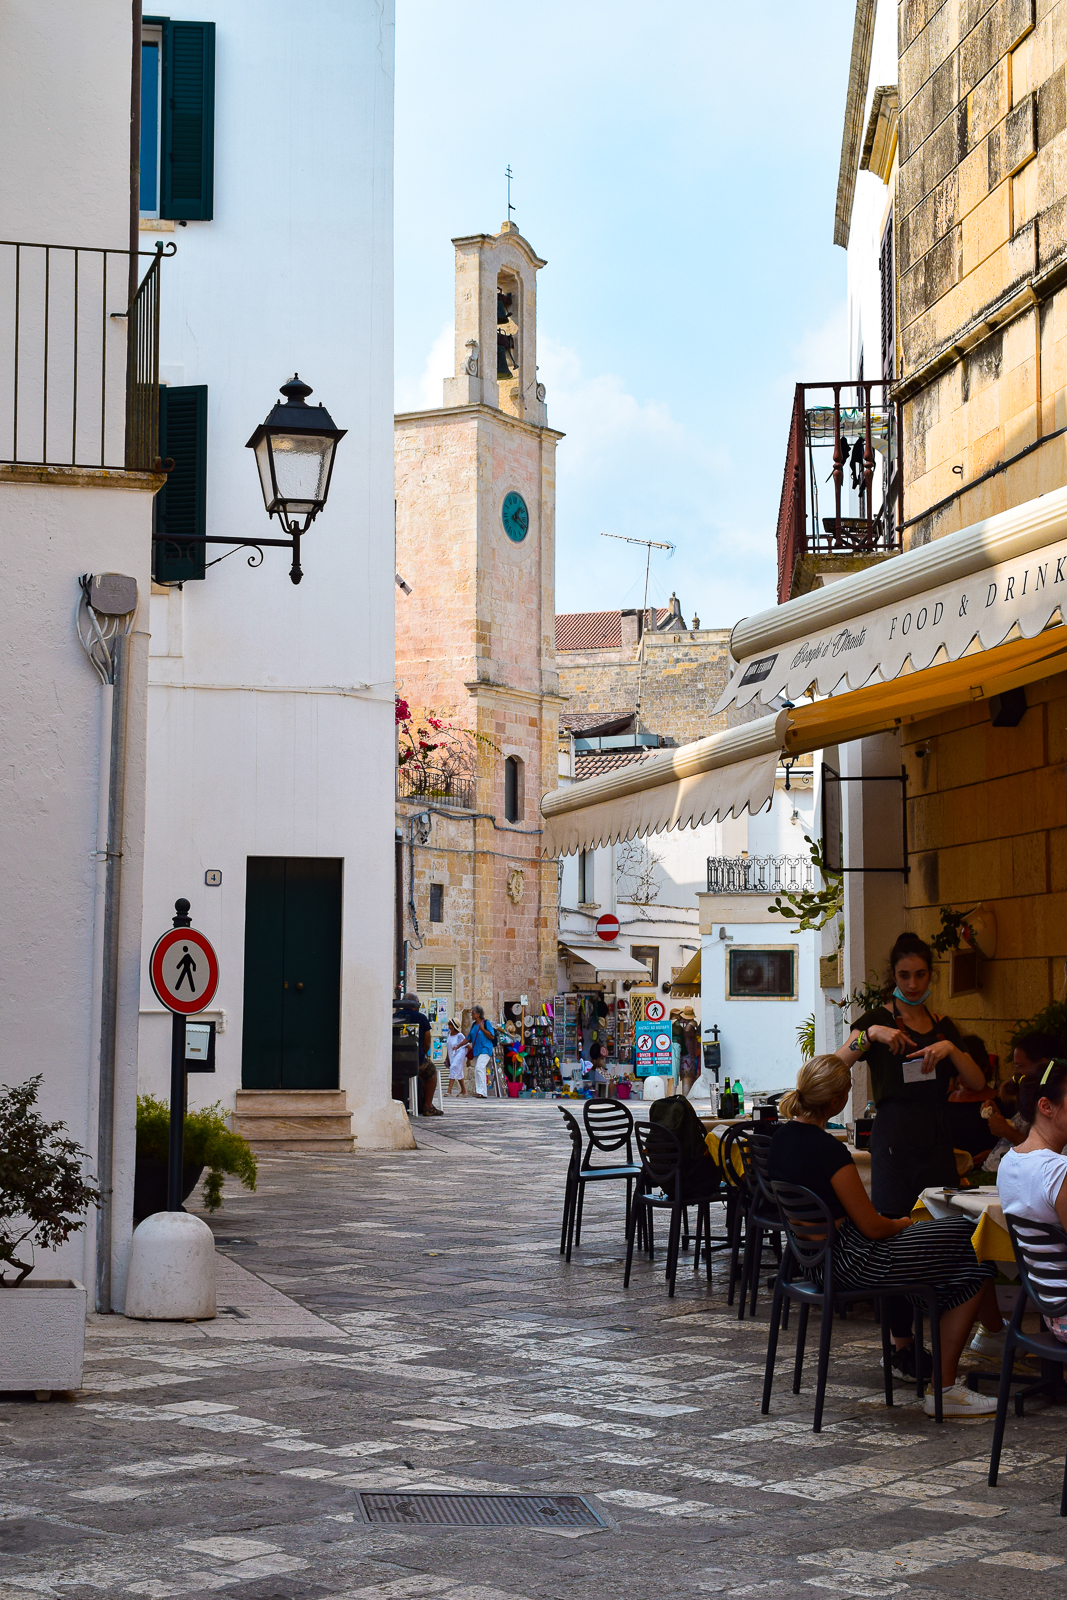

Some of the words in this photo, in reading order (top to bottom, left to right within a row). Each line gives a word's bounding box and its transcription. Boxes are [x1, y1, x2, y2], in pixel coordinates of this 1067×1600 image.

[888, 602, 944, 640] FOOD
[958, 594, 971, 617] &
[985, 556, 1067, 608] DRINK
